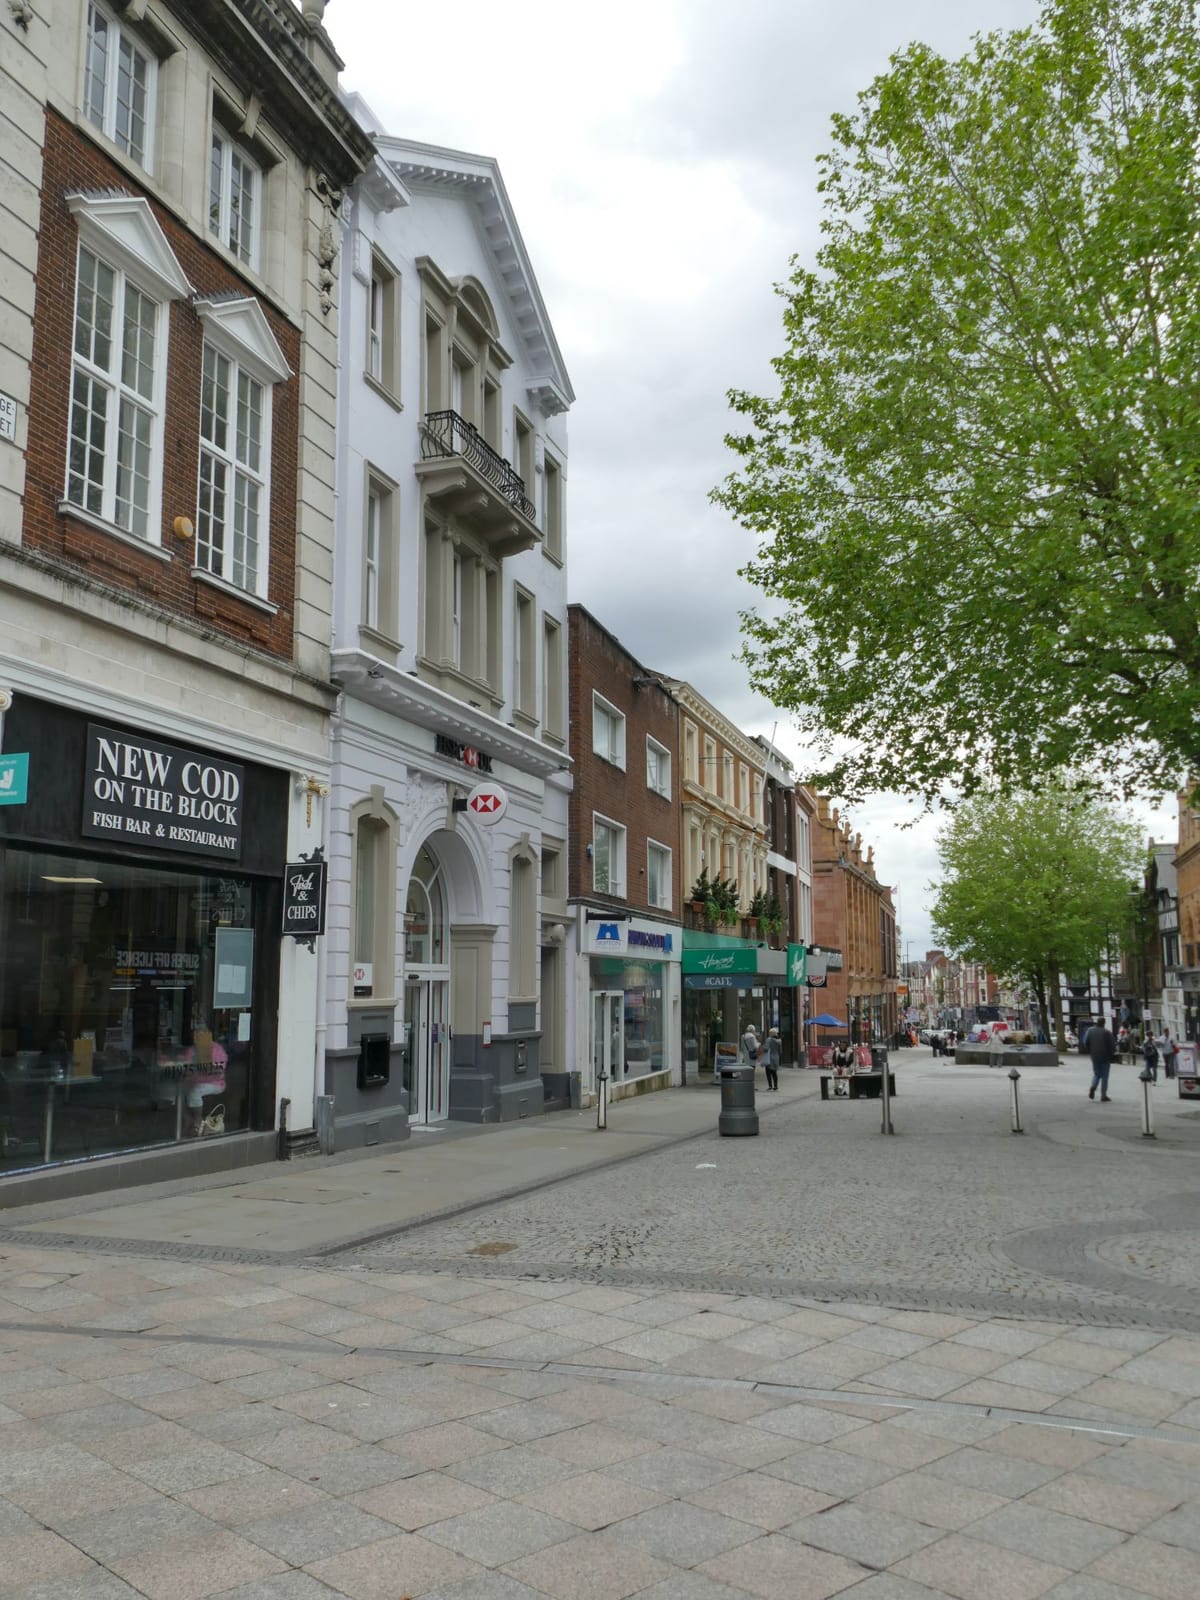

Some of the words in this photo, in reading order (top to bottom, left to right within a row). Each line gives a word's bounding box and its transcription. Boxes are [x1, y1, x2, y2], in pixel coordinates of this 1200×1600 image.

[95, 737, 173, 787] NEW
[182, 762, 240, 802] COD
[94, 777, 126, 804] ON
[131, 785, 173, 813] THE
[177, 795, 238, 826] BLOCK
[92, 811, 123, 830] FISH
[126, 817, 150, 835] BAR
[155, 824, 166, 837] &
[169, 826, 237, 850] RESTAURANT
[290, 872, 315, 896] Fish
[297, 891, 309, 901] &
[287, 905, 317, 920] CHIPS
